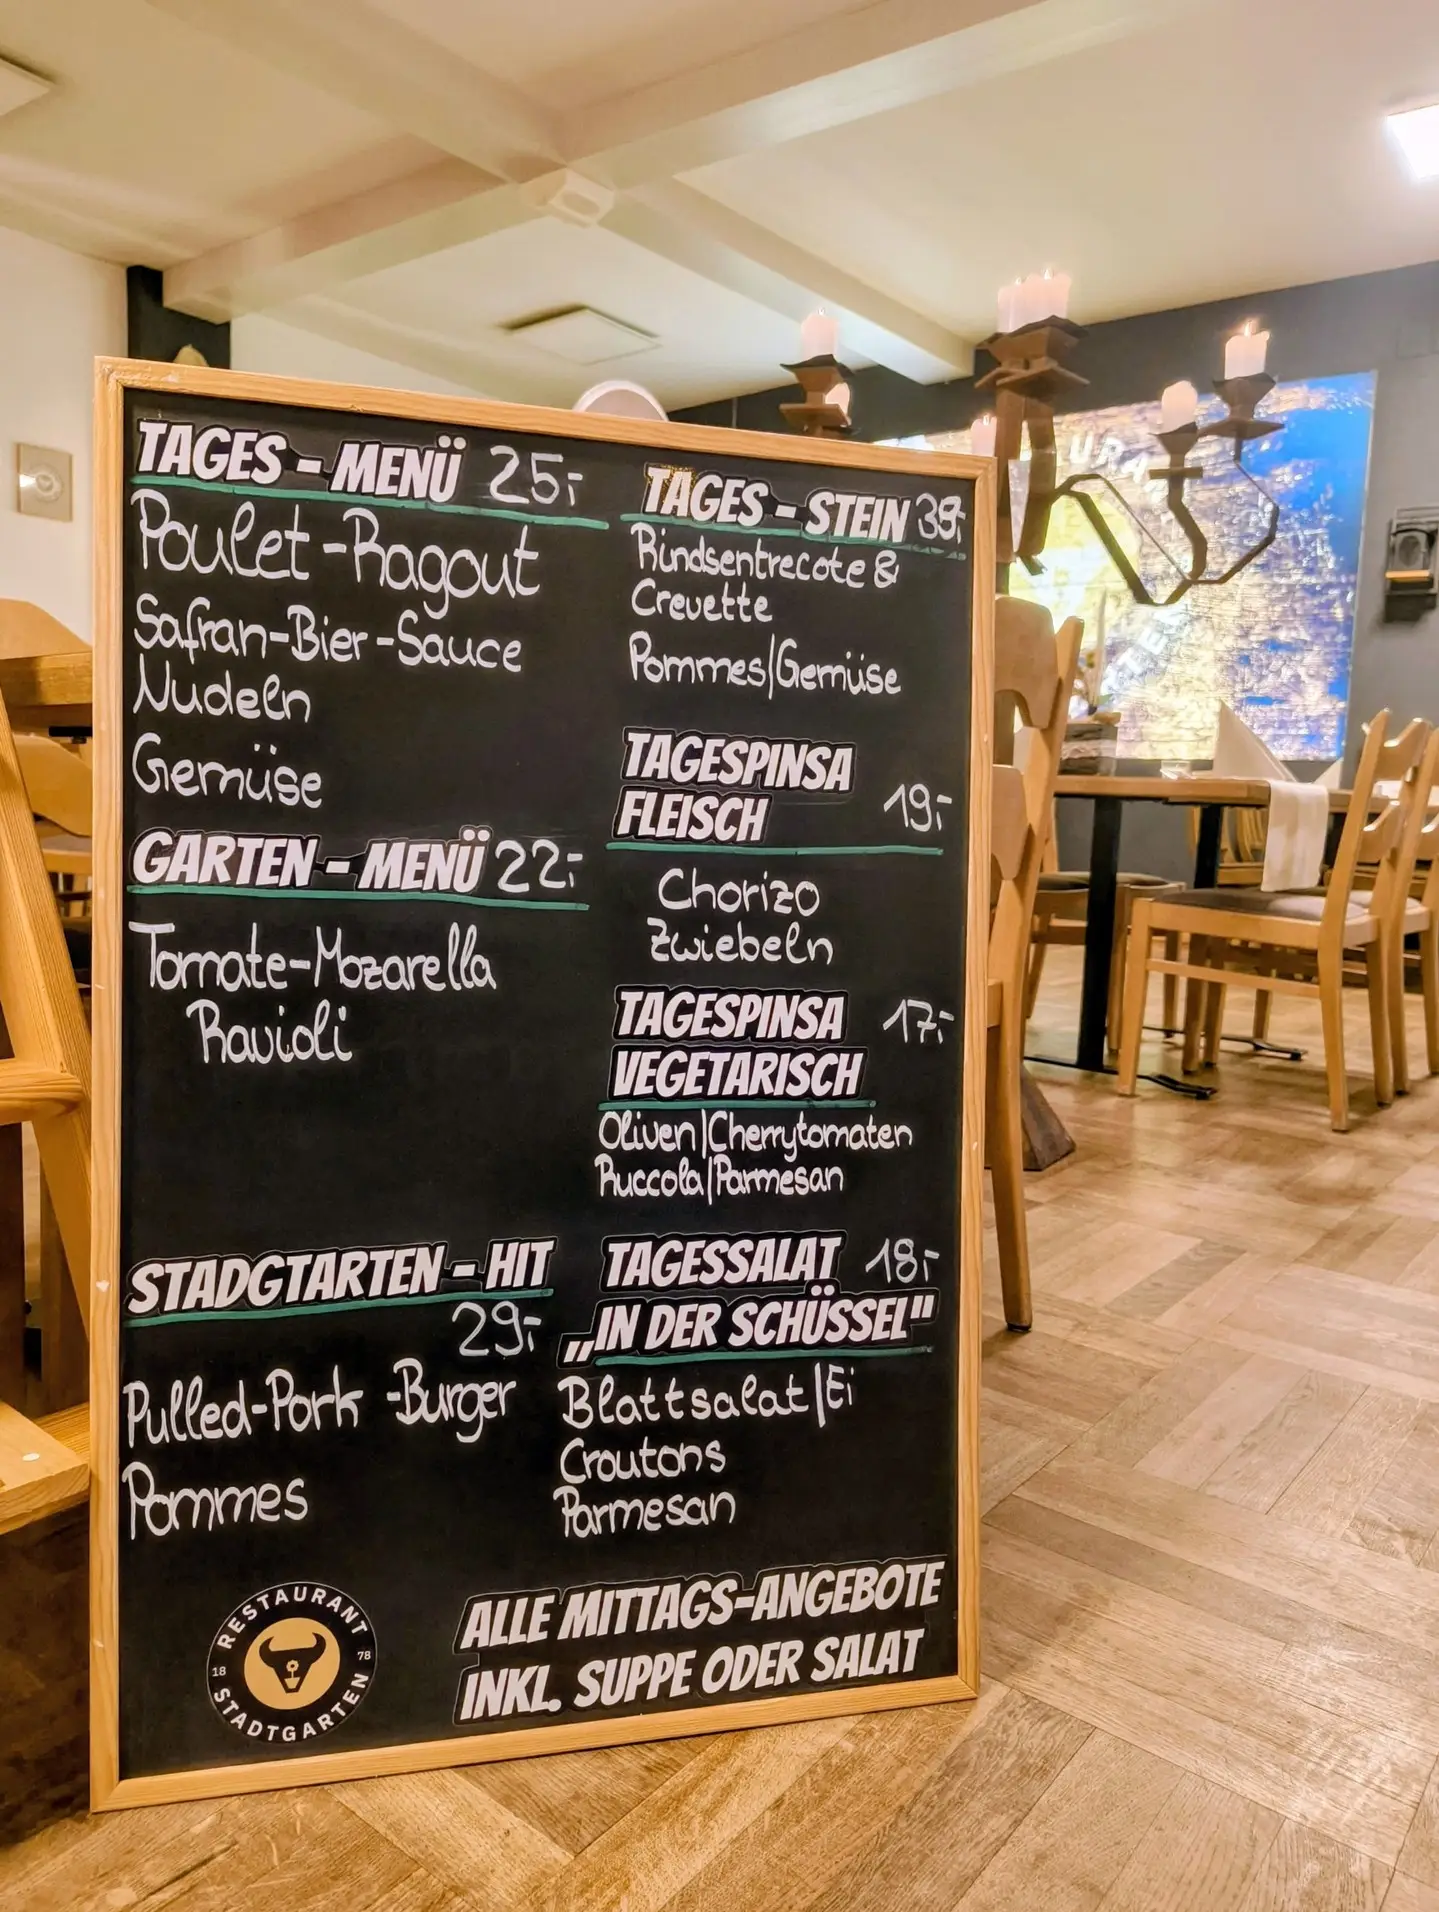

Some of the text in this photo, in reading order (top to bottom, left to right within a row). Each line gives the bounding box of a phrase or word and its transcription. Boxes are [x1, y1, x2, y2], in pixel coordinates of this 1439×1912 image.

[138, 421, 287, 485] TAGES
[330, 435, 467, 504] MENÜ
[644, 466, 769, 531] TAGES
[802, 491, 912, 544] STEIN
[630, 521, 900, 589] Rindsentrecote &
[631, 577, 773, 623] Crevette
[132, 653, 311, 723] Nudeln
[132, 732, 322, 809] Gemüse
[625, 732, 853, 791] TAGESPINSA
[616, 790, 769, 842] FLEISCH
[133, 829, 318, 887] GARTEN
[357, 828, 491, 893] MENÜ
[658, 867, 820, 917] Chorizo
[646, 917, 834, 965] Zwiebeln
[185, 998, 353, 1065] Ravioli
[618, 991, 845, 1040] TAGESPINSA
[613, 1050, 864, 1098] VEGETARISCH
[127, 1245, 445, 1314] STADGTARTEN
[485, 1240, 555, 1290] HIT
[606, 1236, 842, 1287] TAGESSALAT
[644, 1303, 722, 1350] DER
[560, 1436, 726, 1484] Croutons
[122, 1461, 308, 1540] Pommes
[552, 1485, 736, 1538] Parmesan
[217, 1586, 368, 1650] RESTAURANT
[459, 1561, 945, 1650] ALLE MITTAGS-ANGEBOTE
[212, 1650, 371, 1677] 18 78
[460, 1628, 925, 1721] INKL. SUPPE ODER SALAT
[213, 1672, 369, 1742] STADTGARTEN
